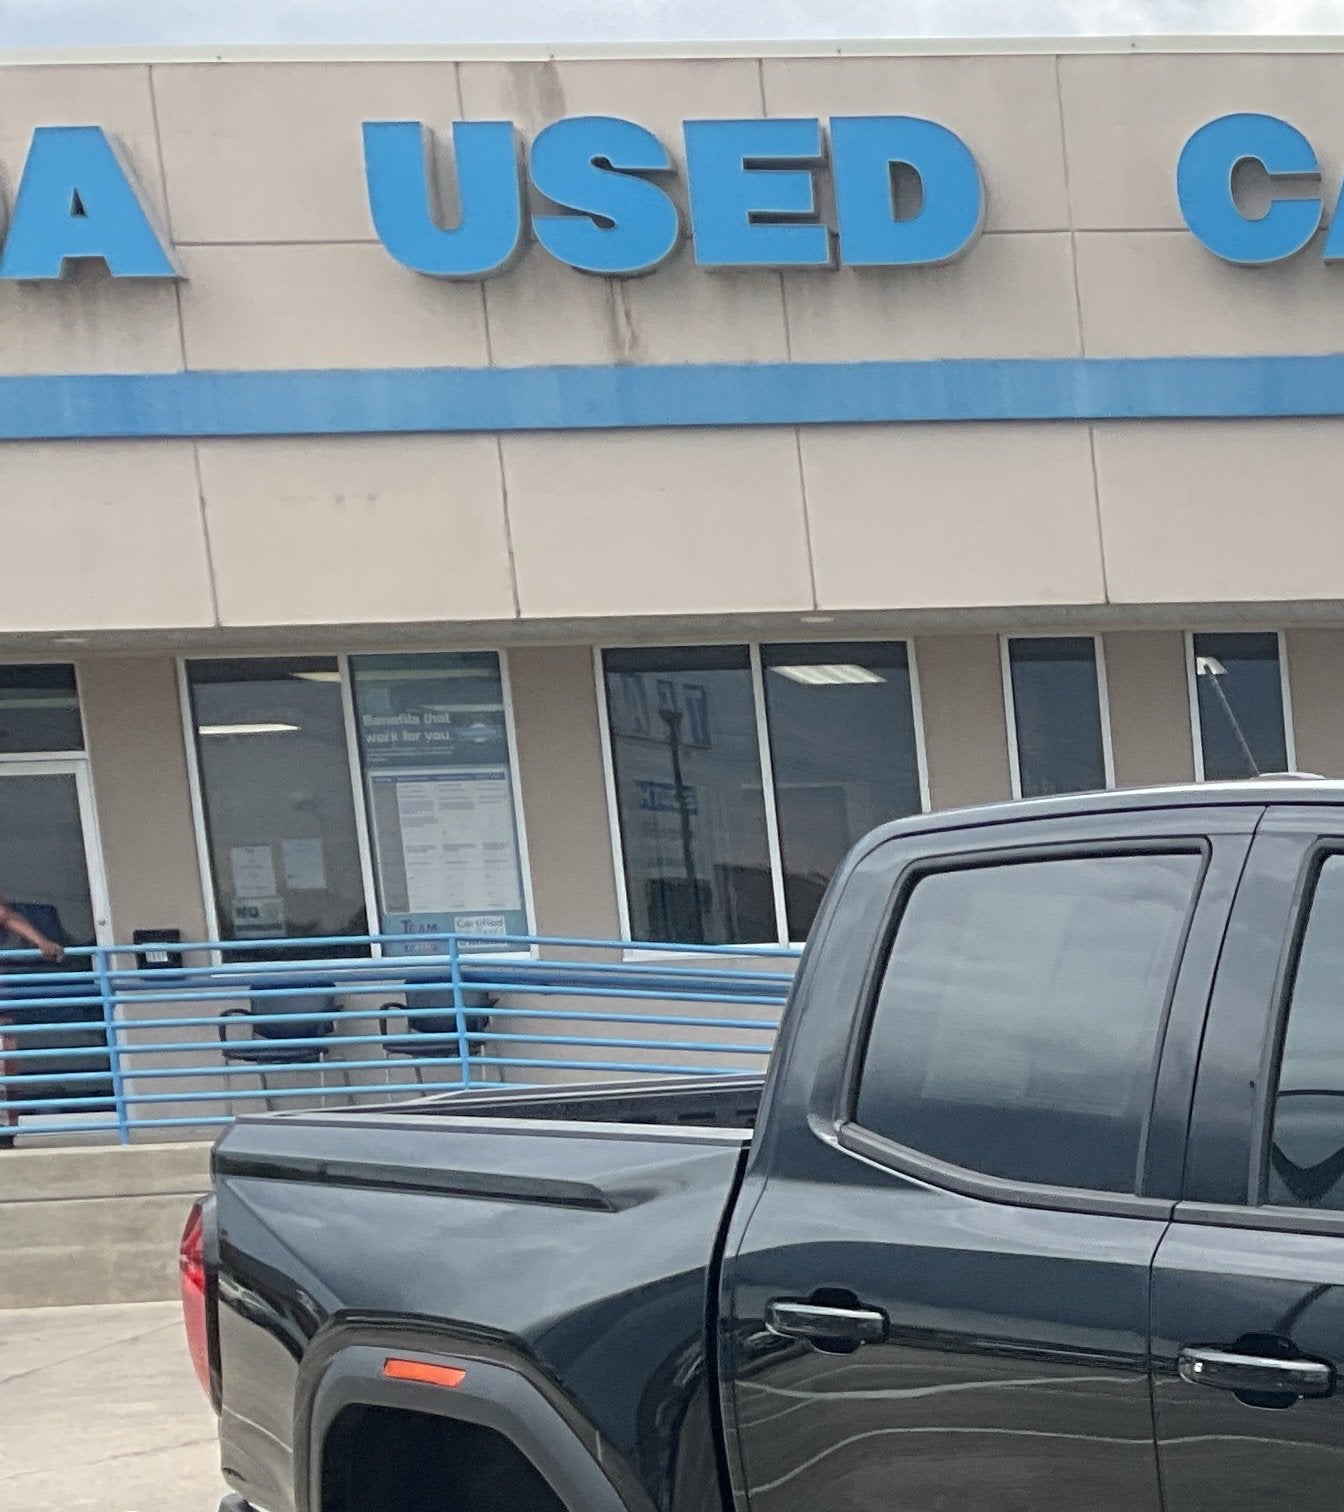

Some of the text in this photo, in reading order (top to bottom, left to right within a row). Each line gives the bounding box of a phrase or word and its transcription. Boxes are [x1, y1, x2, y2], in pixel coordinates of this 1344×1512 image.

[363, 115, 980, 275] USED
[363, 712, 450, 726] Benefits that
[366, 731, 399, 743] work
[402, 731, 422, 741] for
[423, 732, 450, 743] you
